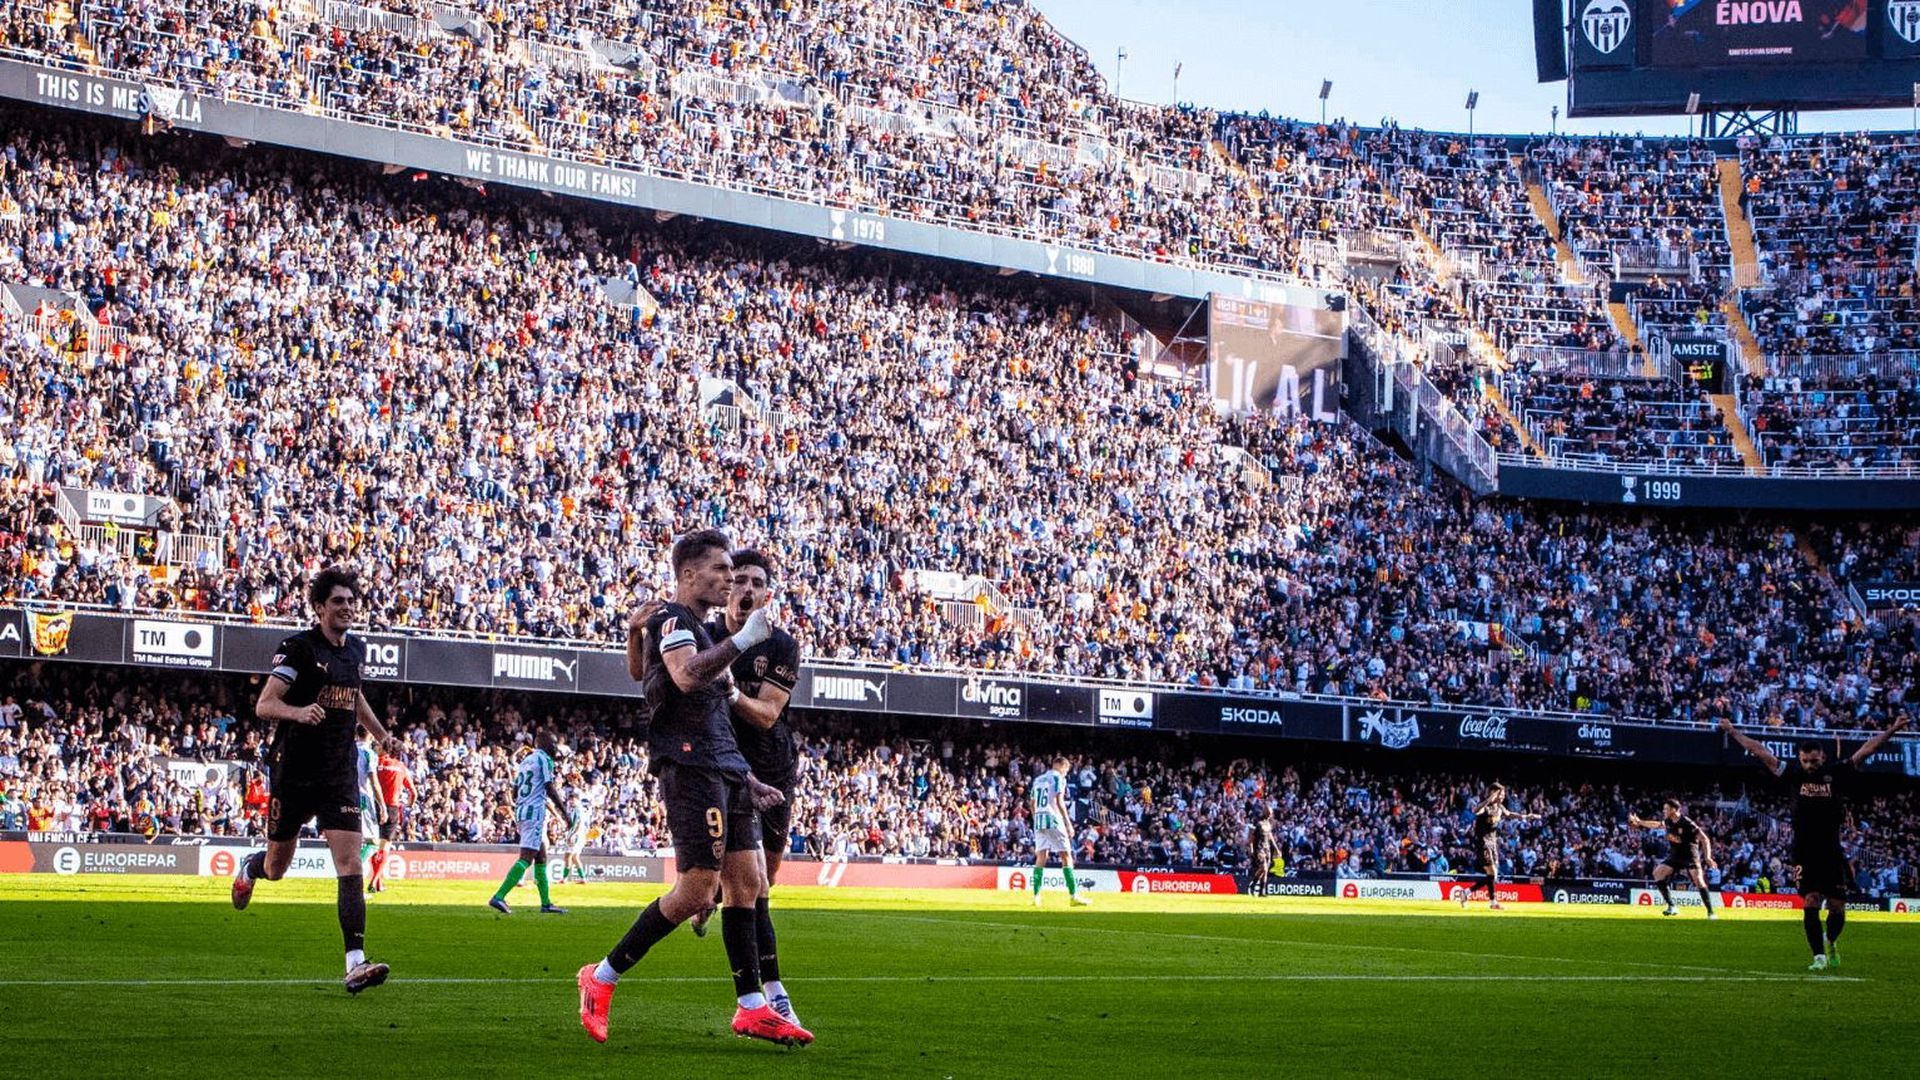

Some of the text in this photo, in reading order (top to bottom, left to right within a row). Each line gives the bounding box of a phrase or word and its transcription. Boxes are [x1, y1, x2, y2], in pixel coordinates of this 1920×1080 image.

[1716, 0, 1803, 25] ÉNOVA
[36, 73, 202, 123] THIS IS MESLA
[466, 150, 637, 198] WE THANK OUR FANS!
[852, 217, 885, 241] 1979
[1064, 253, 1095, 276] 1980
[1672, 343, 1720, 356] AMSTEL
[1644, 481, 1681, 500] 1999
[93, 498, 111, 509] TM
[140, 630, 166, 646] TM
[133, 654, 212, 668] TM Real Estate Group
[494, 653, 554, 680] PUMA
[813, 676, 866, 700] PUMA
[962, 679, 1021, 706] divina
[989, 705, 1020, 717] seguros
[1104, 697, 1121, 711] TM
[1221, 707, 1282, 725] SKODA
[1578, 724, 1611, 739] divina
[173, 769, 192, 781] TM
[1036, 788, 1049, 808] 16
[706, 807, 723, 838] 9
[85, 854, 176, 867] EUROREPAR
[409, 861, 491, 873] EUROREPAR
[1151, 880, 1211, 892] EUROREPAR
[1267, 884, 1323, 895] EUROREPAR
[1360, 887, 1414, 897] EUROREPAR
